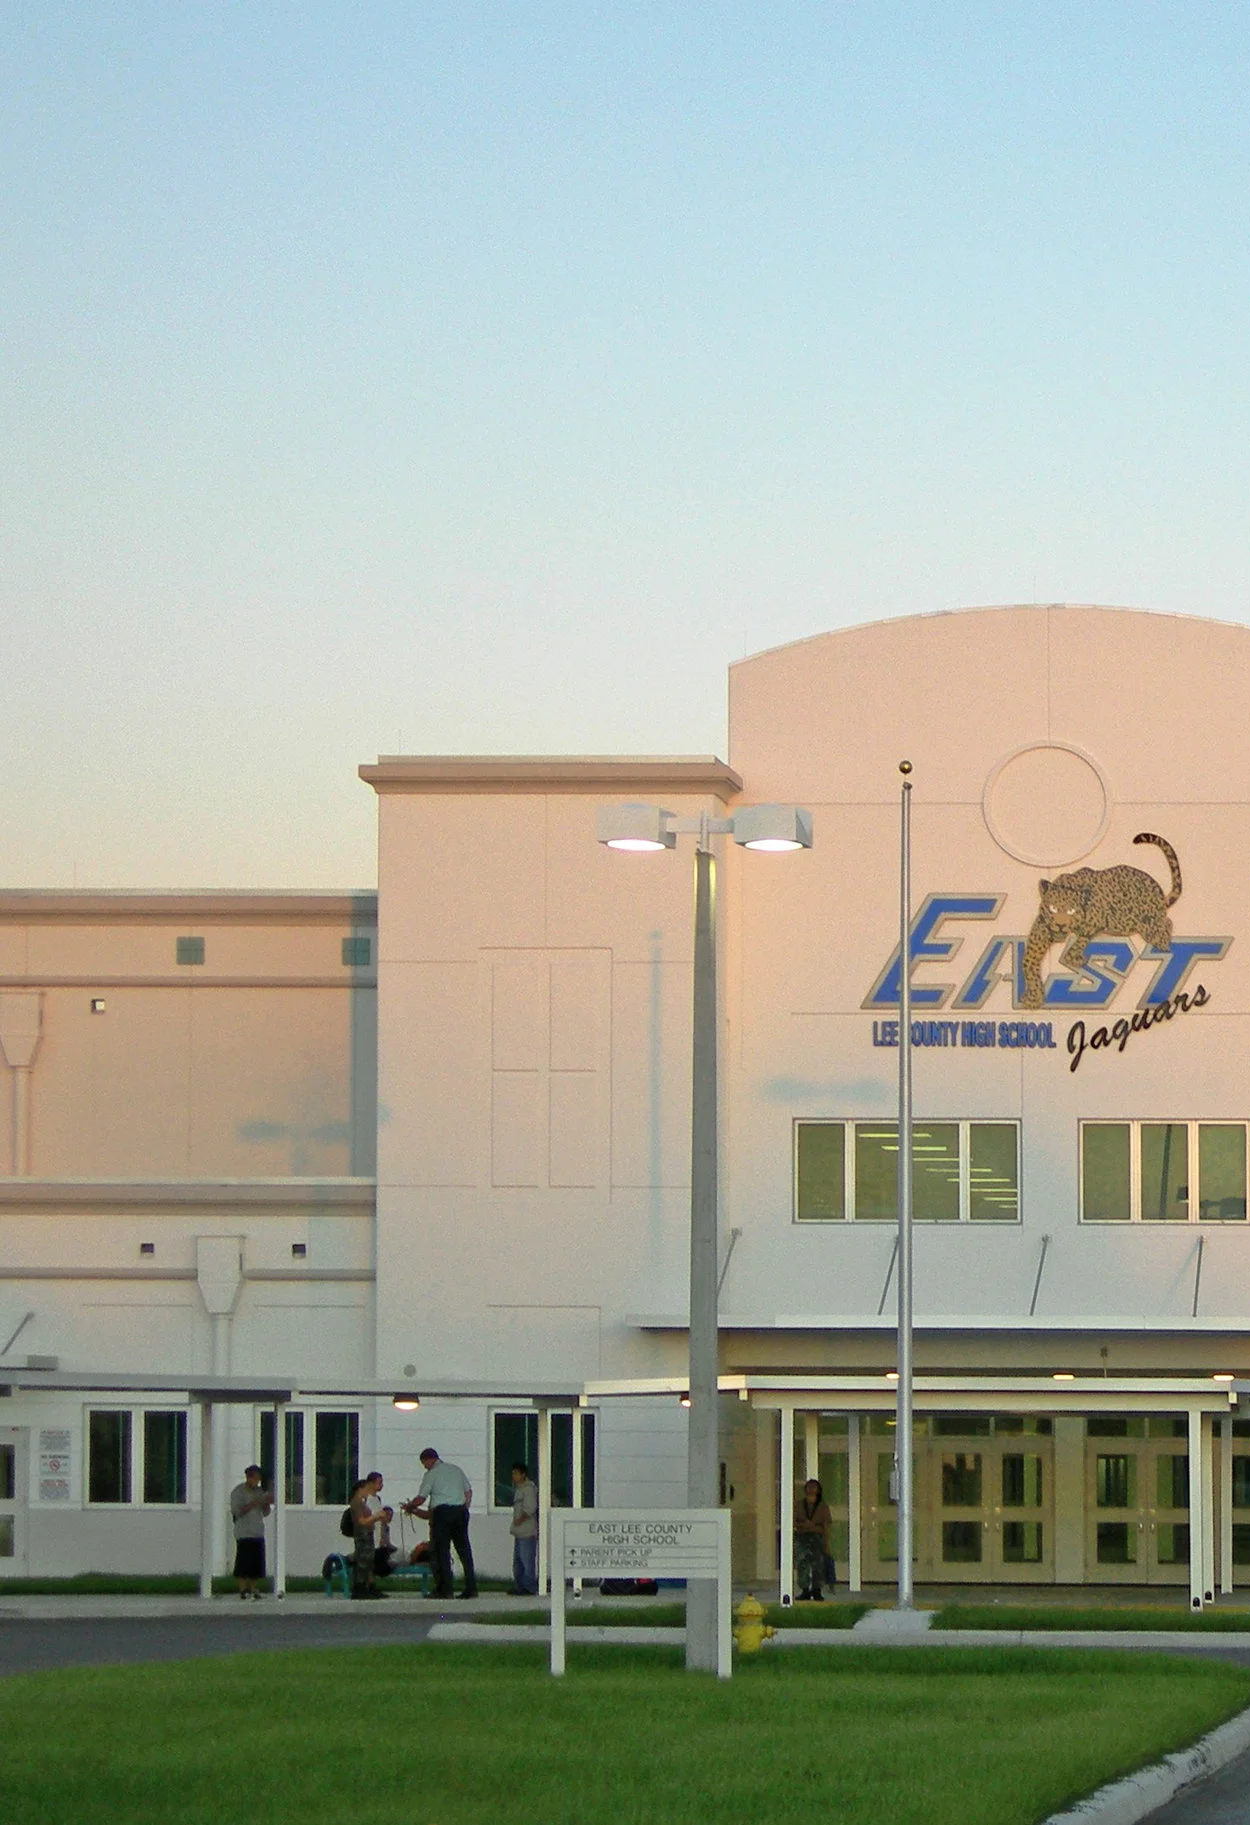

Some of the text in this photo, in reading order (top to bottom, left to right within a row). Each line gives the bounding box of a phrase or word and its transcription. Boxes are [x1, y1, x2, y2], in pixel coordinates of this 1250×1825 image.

[860, 892, 1234, 1010] EAST
[1067, 984, 1211, 1072] Jaguars
[872, 1020, 1057, 1048] LEE OUNTY HIGH SCHOOL
[589, 1523, 692, 1534] EAST LEE COUNTY
[602, 1535, 680, 1545] HIGH SCHOOL
[580, 1548, 614, 1557] PARENT
[640, 1548, 652, 1557] UP
[610, 1559, 648, 1567] PARKING
